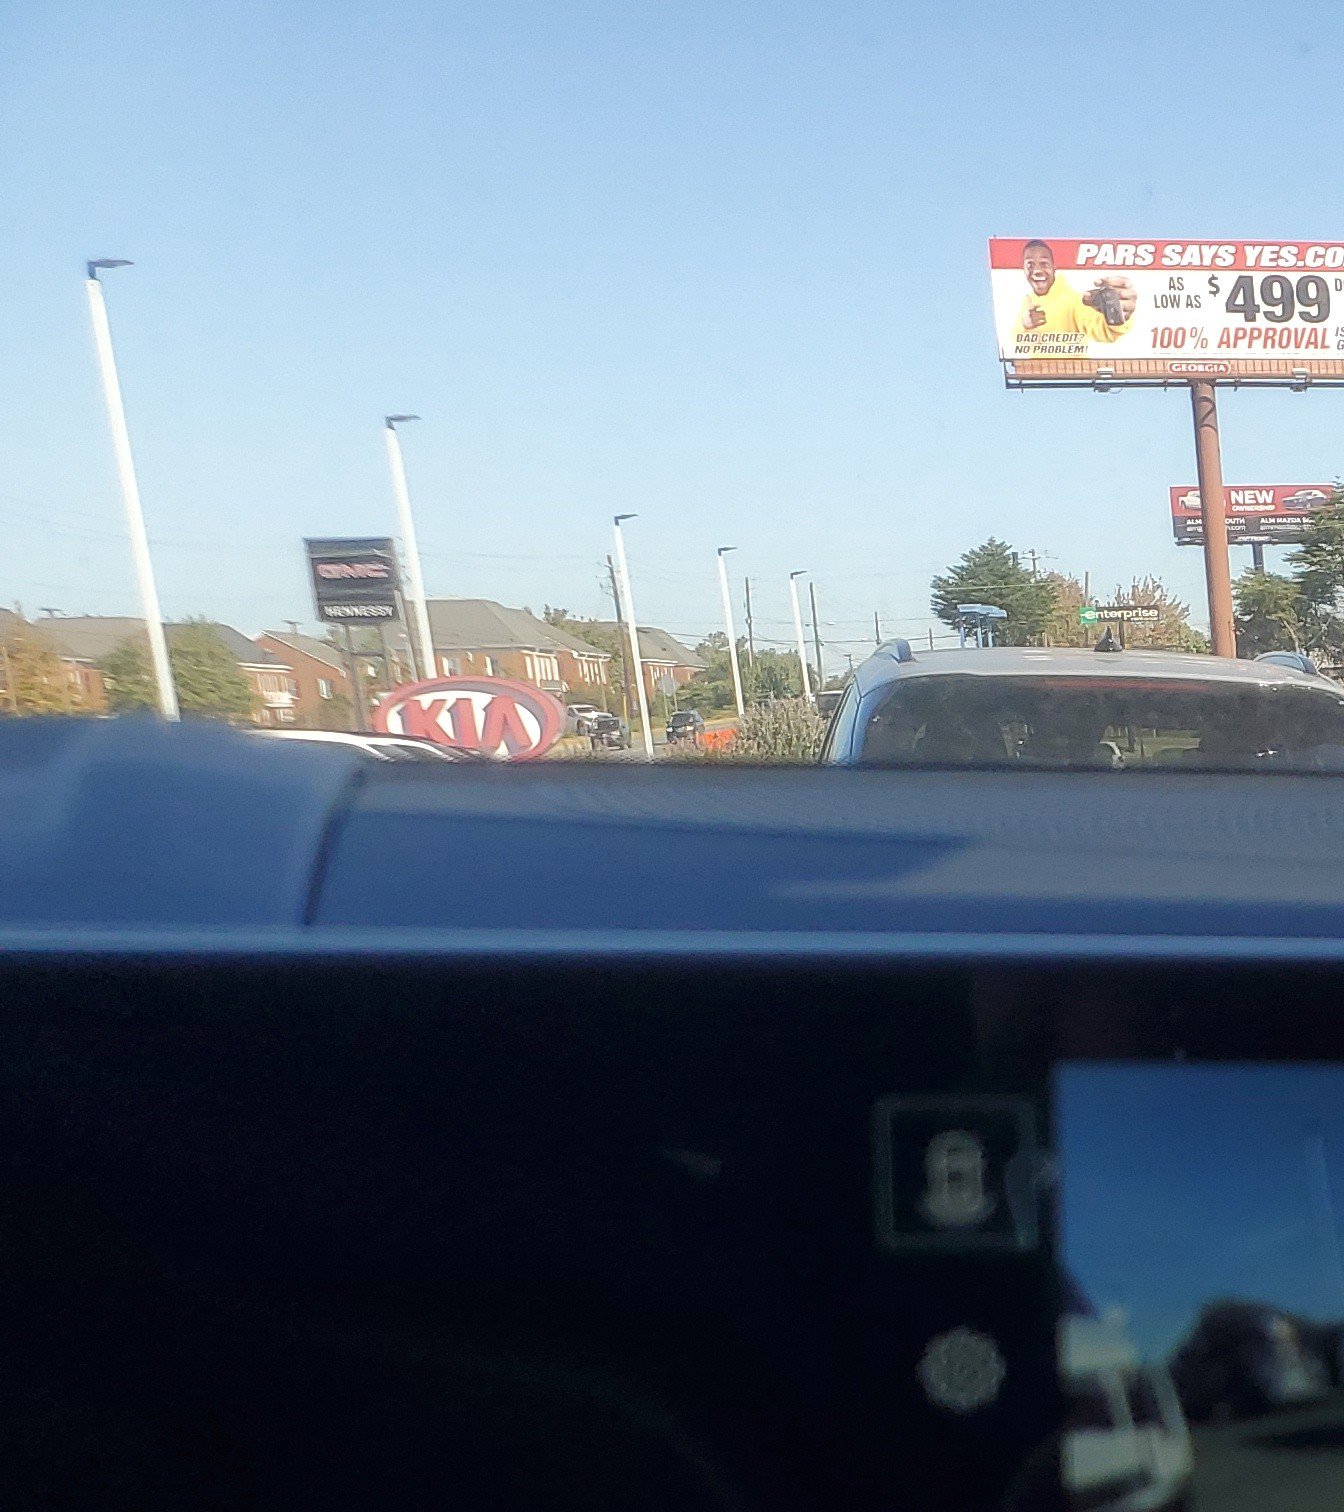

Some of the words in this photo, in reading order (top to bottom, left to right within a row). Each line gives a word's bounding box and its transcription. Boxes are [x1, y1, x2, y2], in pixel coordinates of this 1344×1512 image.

[1076, 243, 1155, 266] PARS
[1161, 244, 1236, 267] SAYS
[1168, 277, 1184, 291] AS
[1154, 294, 1180, 308] LOW
[1186, 294, 1201, 308] AS
[1016, 334, 1038, 342] BAD
[1041, 333, 1085, 342] CREDIT?
[1151, 327, 1208, 349] 100%
[1217, 327, 1330, 349] APPROVAL
[1015, 346, 1030, 354] NO
[1033, 345, 1088, 354] PROBLEM!
[1171, 364, 1225, 373] GEORGIA
[1230, 490, 1275, 504] NEW
[323, 605, 394, 617] HENNESSY
[1083, 608, 1158, 620] enterprise
[399, 696, 532, 754] KIA
